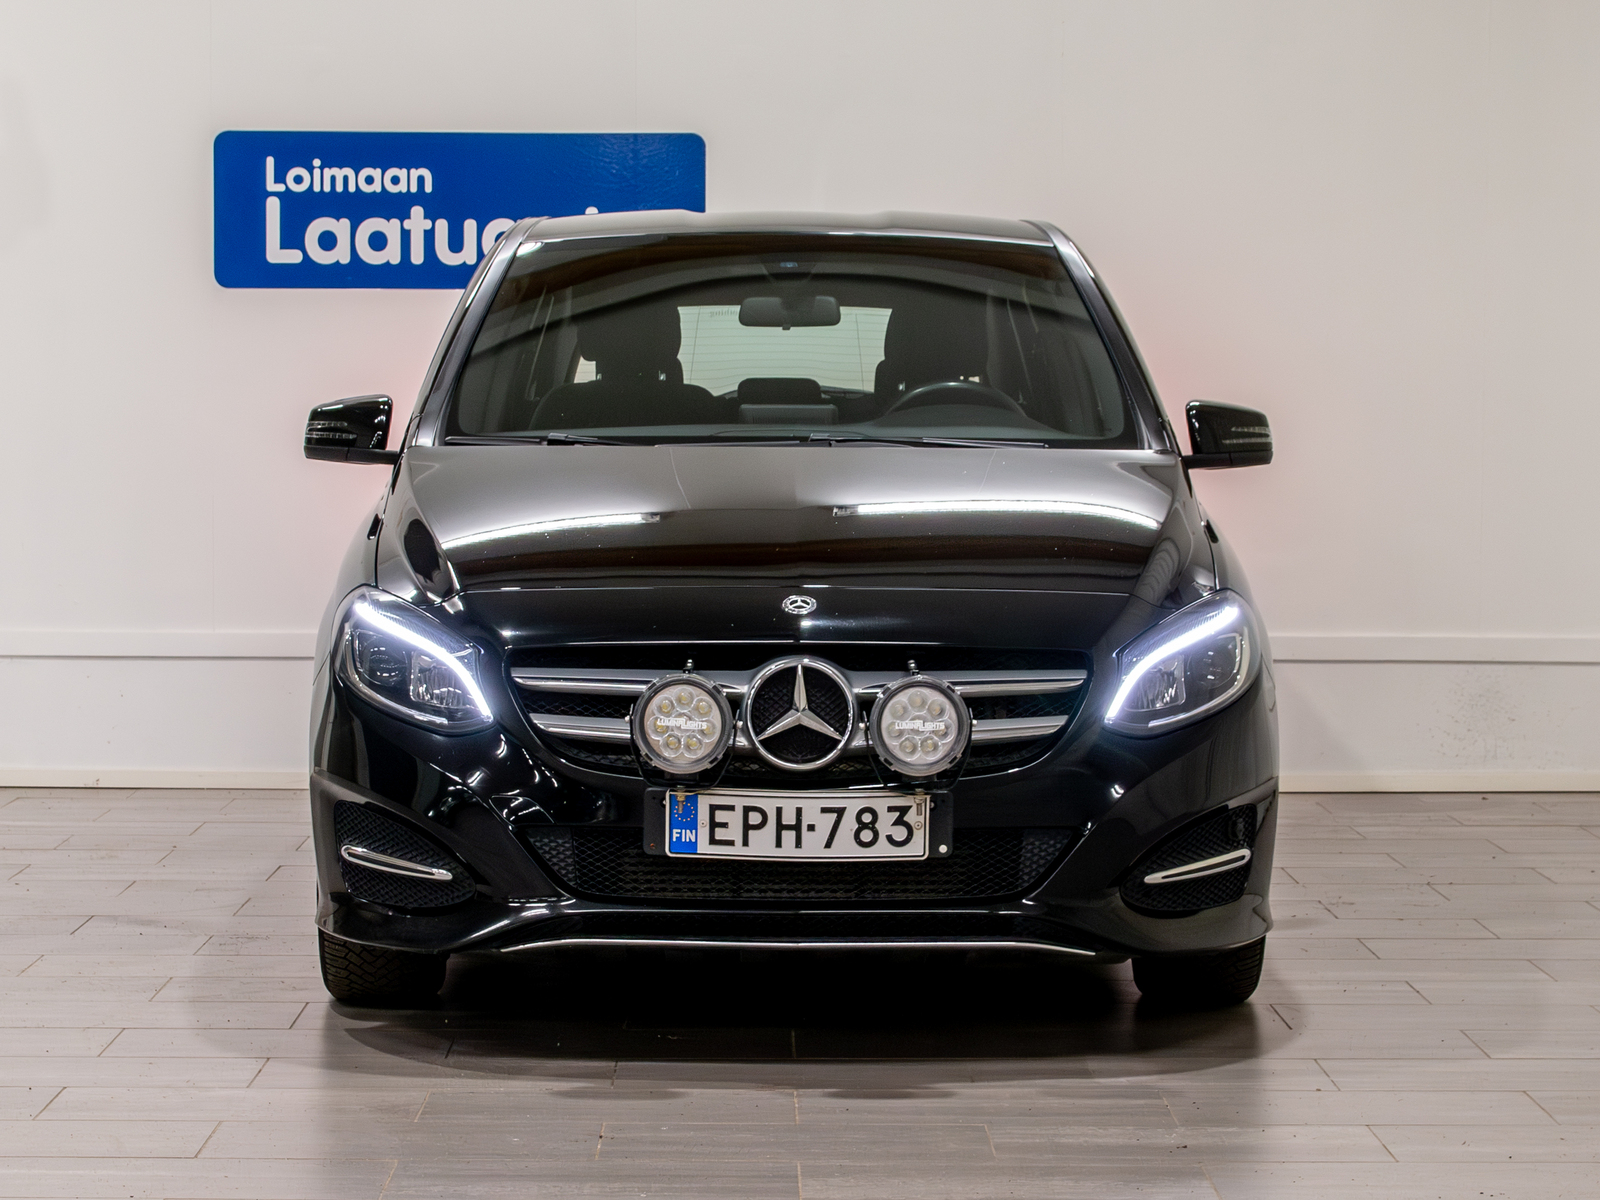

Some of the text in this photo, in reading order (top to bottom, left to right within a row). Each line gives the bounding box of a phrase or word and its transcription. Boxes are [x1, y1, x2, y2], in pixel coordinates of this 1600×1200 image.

[265, 155, 433, 193] Loimaan
[672, 828, 696, 843] FIN
[708, 803, 914, 849] EPH-783
